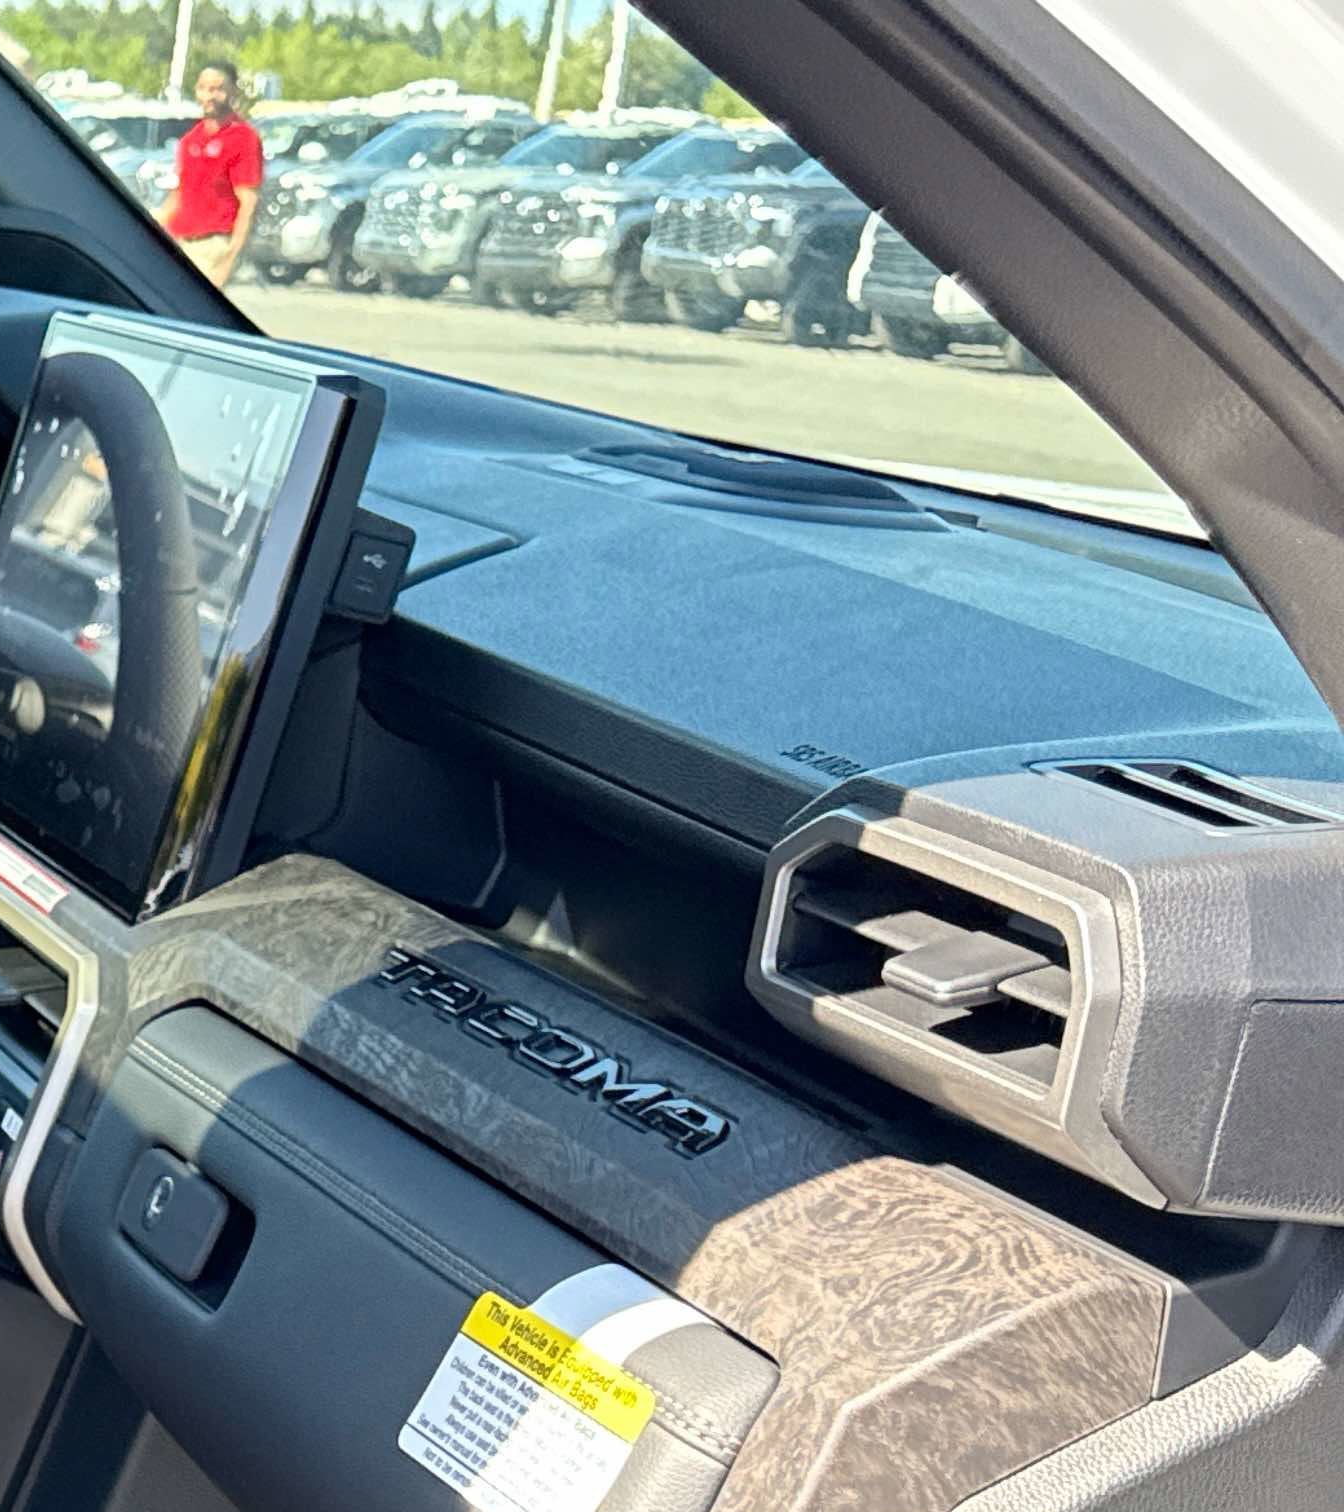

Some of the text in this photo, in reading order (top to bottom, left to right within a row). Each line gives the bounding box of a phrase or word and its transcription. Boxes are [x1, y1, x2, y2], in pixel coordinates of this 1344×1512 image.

[805, 755, 871, 778] AIRB
[379, 948, 732, 1156] TACOMA
[484, 1301, 512, 1326] This
[508, 1316, 550, 1350] Vehicle
[547, 1340, 562, 1358] is
[498, 1336, 555, 1379] Advanced
[567, 1381, 602, 1413] Bags
